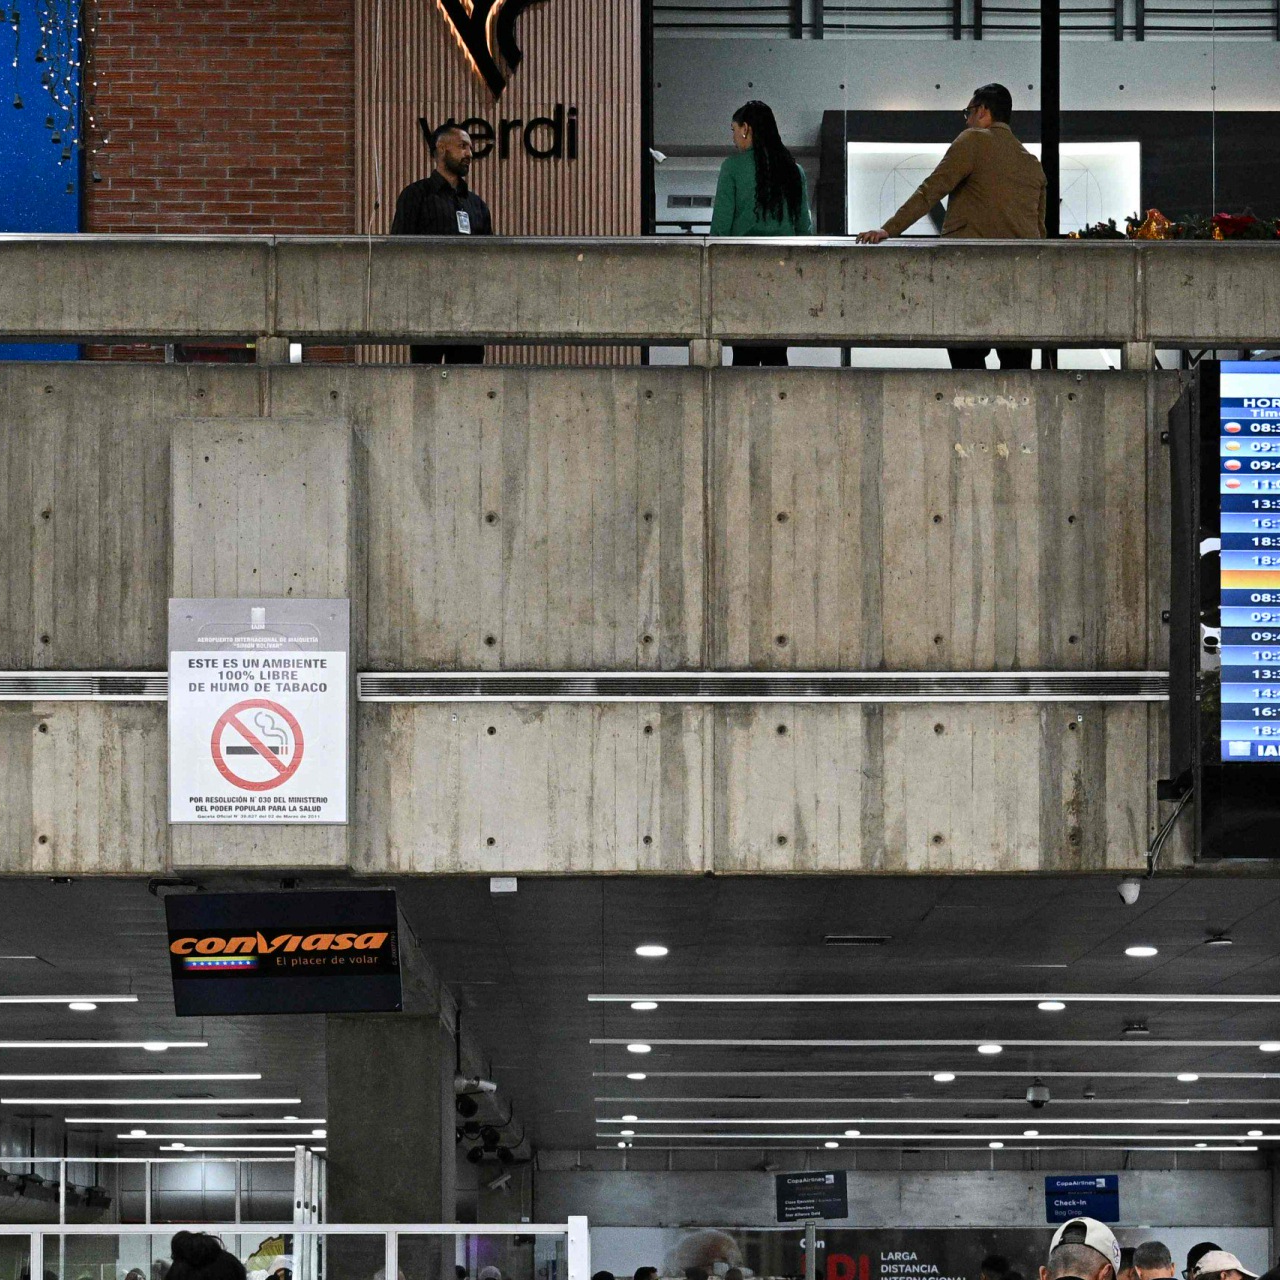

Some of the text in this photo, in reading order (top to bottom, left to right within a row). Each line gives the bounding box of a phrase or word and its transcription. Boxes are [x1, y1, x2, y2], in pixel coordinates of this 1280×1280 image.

[418, 103, 578, 159] verdi
[188, 658, 327, 669] ESTE ES UN AMBIENTE
[218, 670, 299, 681] 100% LIBRE
[188, 682, 328, 693] DE HUMO DE TABACO
[189, 796, 204, 804] POR
[205, 795, 248, 804] RESOLUCIÓN
[258, 796, 272, 804] 030
[273, 796, 286, 804] DEL
[288, 796, 329, 804] MINISTERIO
[170, 931, 389, 955] conviasa
[276, 955, 379, 968] El placer de volar
[1053, 1199, 1087, 1207] Check-In
[799, 1238, 826, 1249] Cn
[880, 1251, 918, 1261] LARGA
[880, 1264, 939, 1274] DISTANCIA
